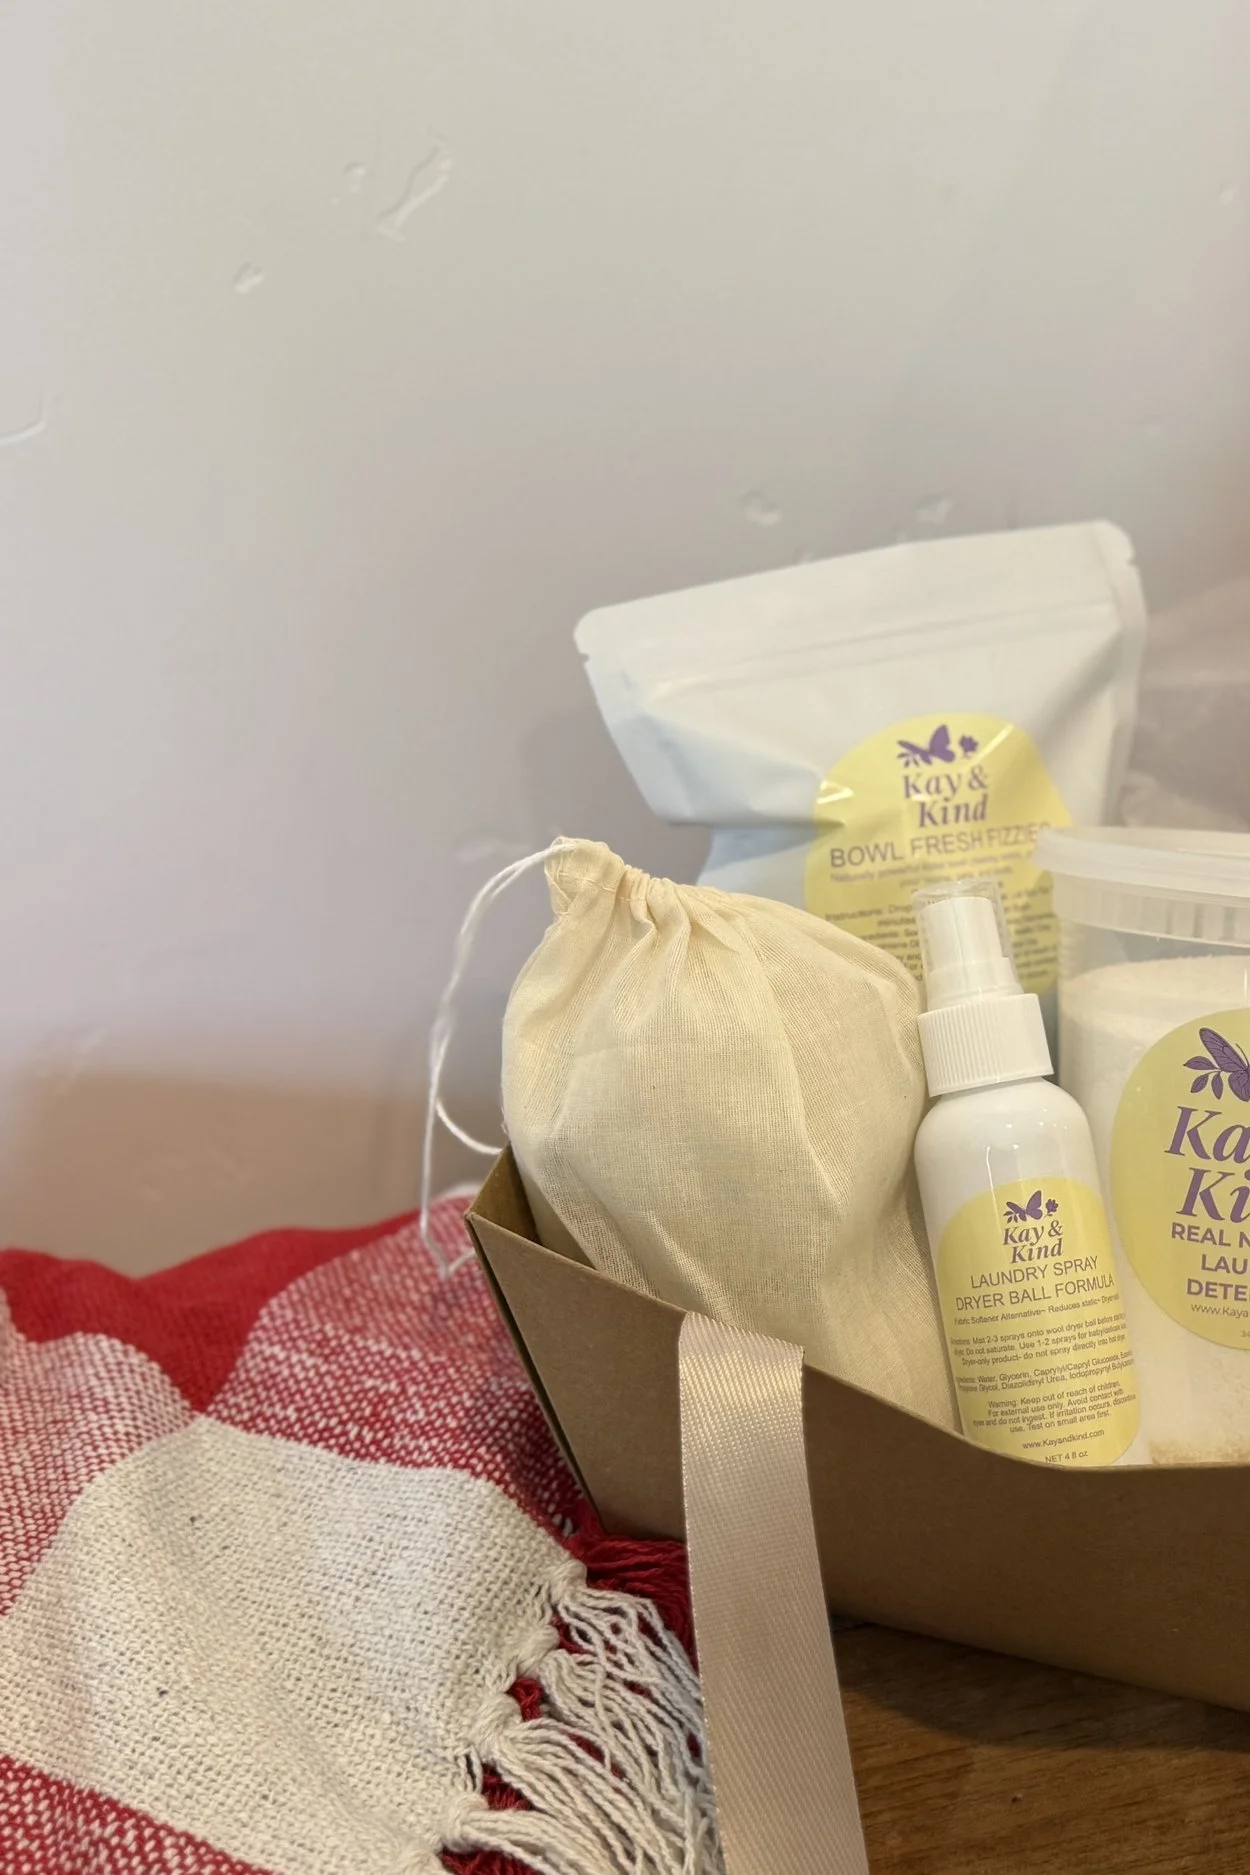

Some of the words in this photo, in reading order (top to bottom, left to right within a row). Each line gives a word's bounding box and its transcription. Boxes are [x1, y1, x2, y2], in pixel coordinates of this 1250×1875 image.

[903, 769, 962, 802] Kay
[968, 764, 988, 791] &
[918, 794, 989, 829] Kind
[829, 842, 905, 869] BOWL
[910, 829, 984, 858] FRESH
[1003, 1225, 1045, 1246] Kay
[1047, 1219, 1064, 1238] &
[1171, 1222, 1231, 1248] REAL
[1010, 1237, 1064, 1264] Kind
[970, 1264, 1049, 1290] LAUNDRY
[1053, 1255, 1099, 1277] SPRAY
[956, 1292, 1005, 1311] DRYER
[1008, 1285, 1052, 1306] BALL
[1055, 1273, 1115, 1298] FORMULA
[1048, 1302, 1081, 1313] Reduces
[986, 1335, 999, 1344] 2-3
[1000, 1332, 1025, 1343] sprays
[1027, 1329, 1045, 1339] onto
[1046, 1324, 1064, 1335] wool
[1065, 1321, 1084, 1332] dryer
[1085, 1318, 1097, 1328] ball
[1018, 1340, 1035, 1350] Use
[1037, 1337, 1051, 1347] 1-2
[1051, 1334, 1077, 1346] sprays
[1077, 1331, 1088, 1340] for
[1023, 1351, 1034, 1360] do
[1036, 1347, 1049, 1358] not
[1050, 1346, 1071, 1357] spray
[1072, 1340, 1096, 1352] directly
[999, 1371, 1032, 1382] Glycerin,
[988, 1409, 1001, 1418] For
[1000, 1405, 1030, 1417] external
[1031, 1404, 1046, 1413] use
[1067, 1396, 1088, 1408] Avoid
[1089, 1391, 1114, 1403] contact
[1020, 1394, 1042, 1406] Keep
[1042, 1392, 1055, 1402] out
[1056, 1391, 1065, 1400] of
[1066, 1386, 1088, 1398] reach
[1088, 1384, 1097, 1395] of
[999, 1415, 1008, 1425] do
[1008, 1414, 1021, 1425] not
[1022, 1410, 1047, 1425] ingest.
[1049, 1410, 1056, 1419] If
[1056, 1405, 1087, 1418] irritation
[1009, 1425, 1025, 1434] use.
[1026, 1421, 1044, 1432] Test
[1044, 1420, 1056, 1429] on
[1056, 1416, 1078, 1427] small
[1078, 1413, 1097, 1423] area
[1022, 1428, 1105, 1449] www.Kayandkind.com
[1045, 1454, 1062, 1464] NET
[1064, 1453, 1071, 1461] 4
[1078, 1451, 1089, 1459] oz
